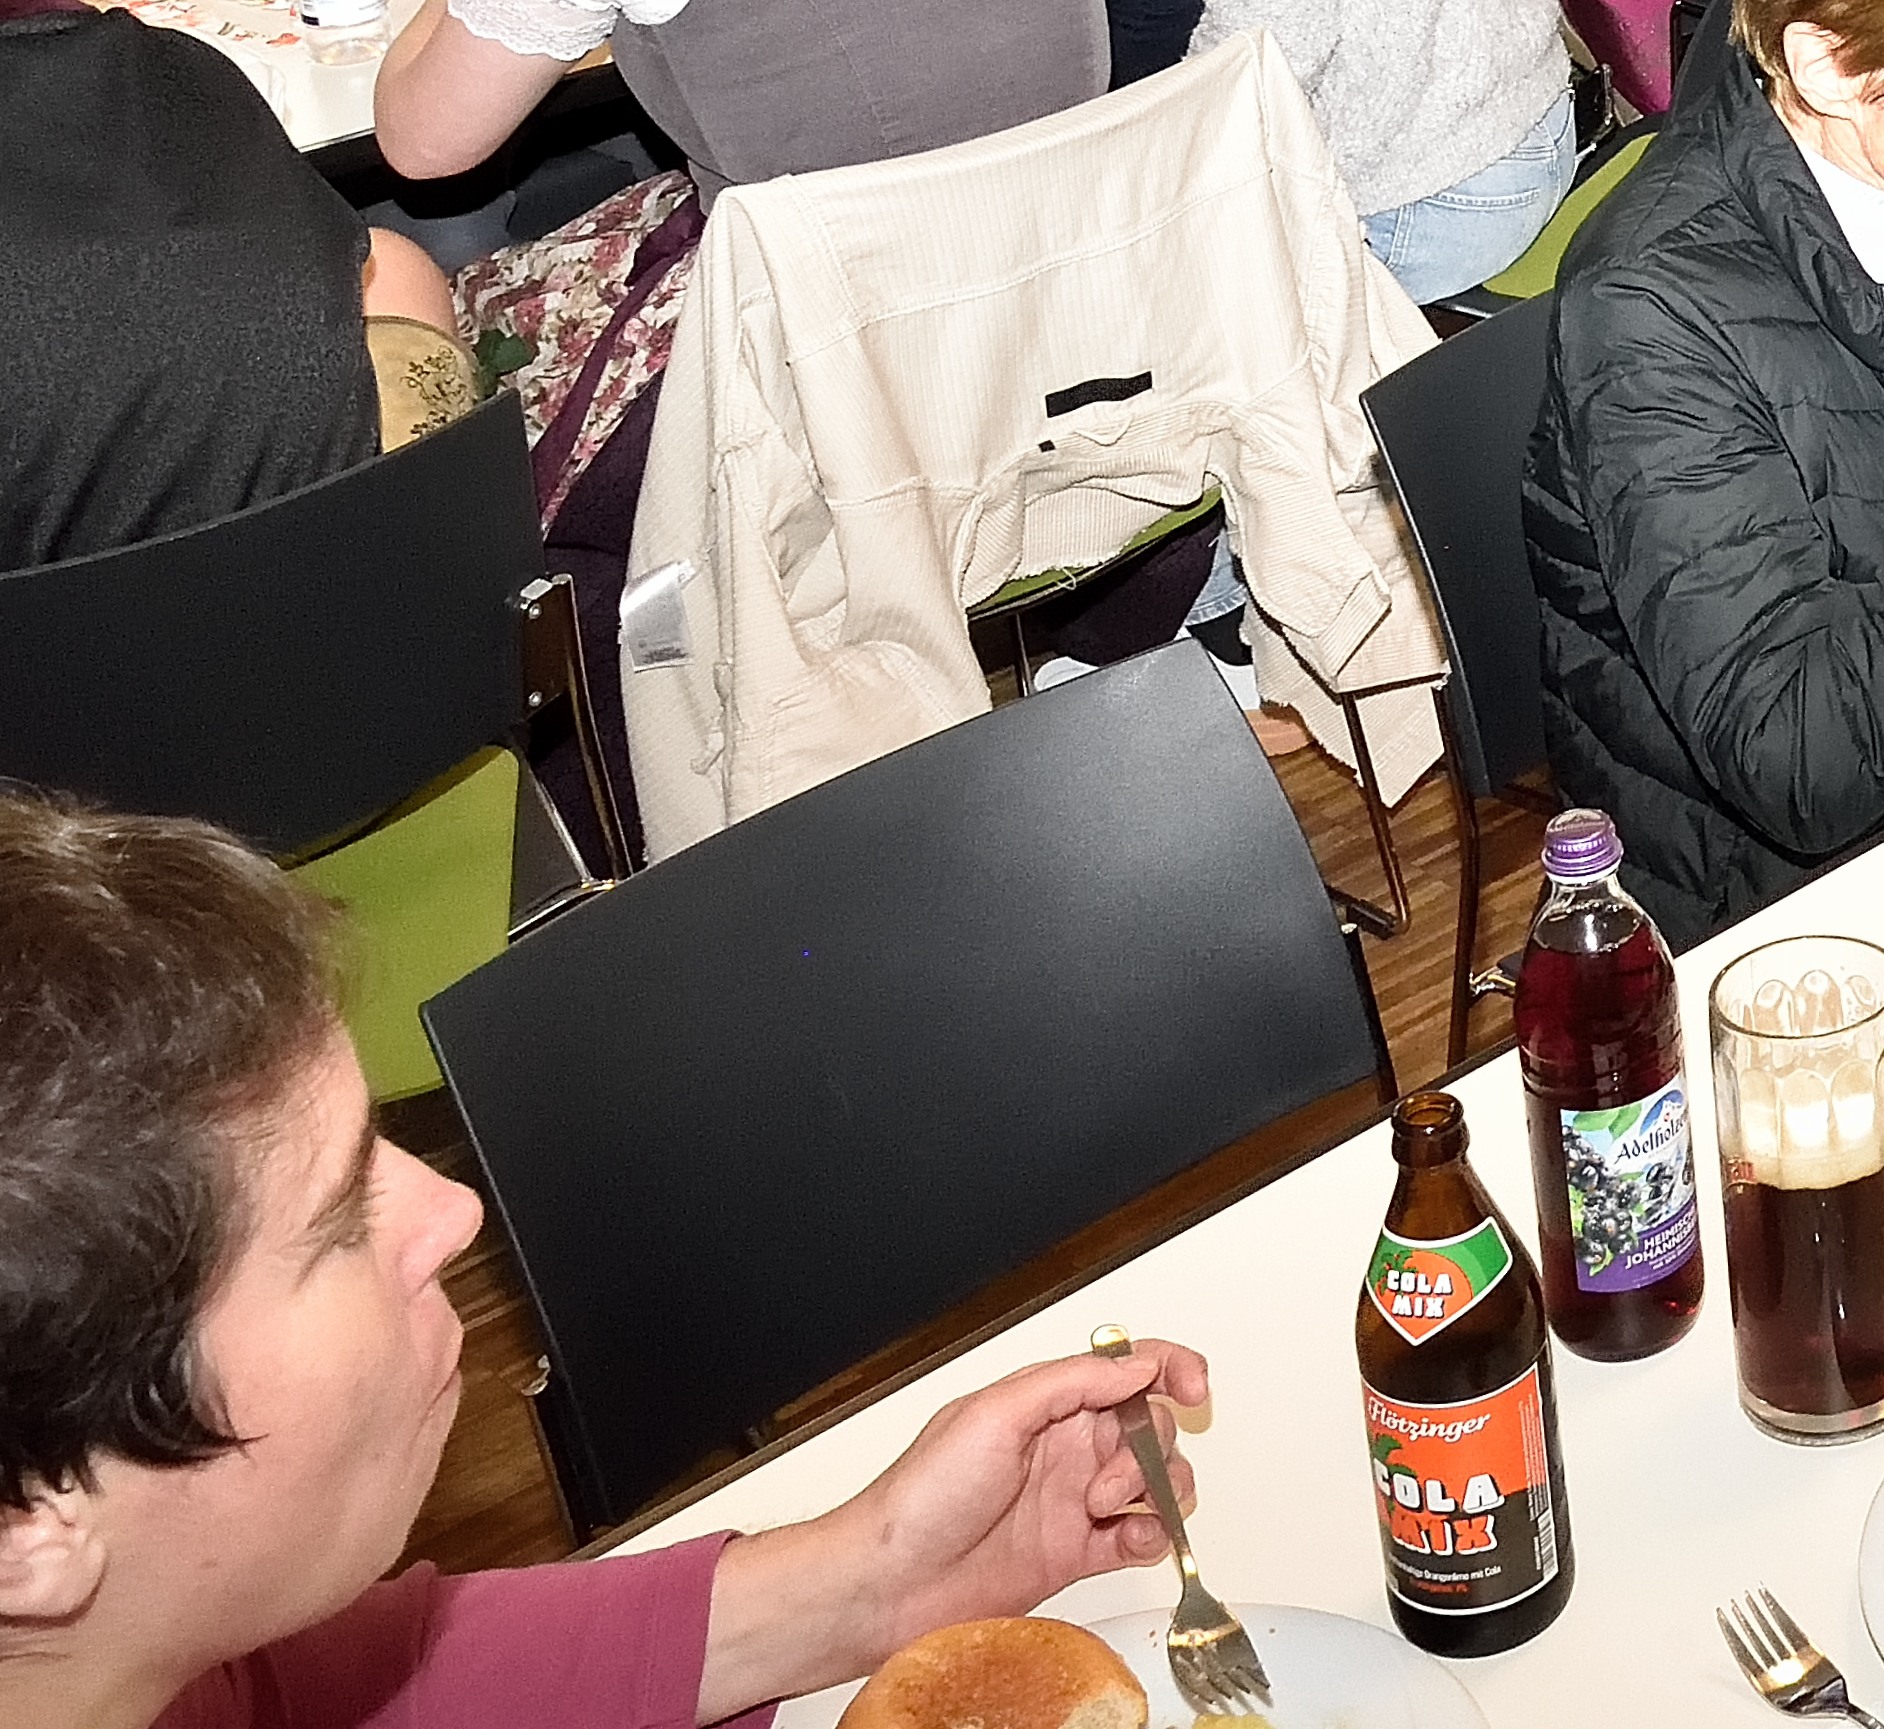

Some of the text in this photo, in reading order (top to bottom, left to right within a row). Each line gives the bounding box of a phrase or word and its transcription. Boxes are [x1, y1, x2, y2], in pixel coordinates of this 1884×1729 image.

[1386, 1269, 1454, 1295] COLA
[1391, 1294, 1444, 1319] MIX
[1368, 1395, 1491, 1443] Flötzinger
[1373, 1457, 1505, 1514] COLA
[1389, 1513, 1498, 1556] MIX
